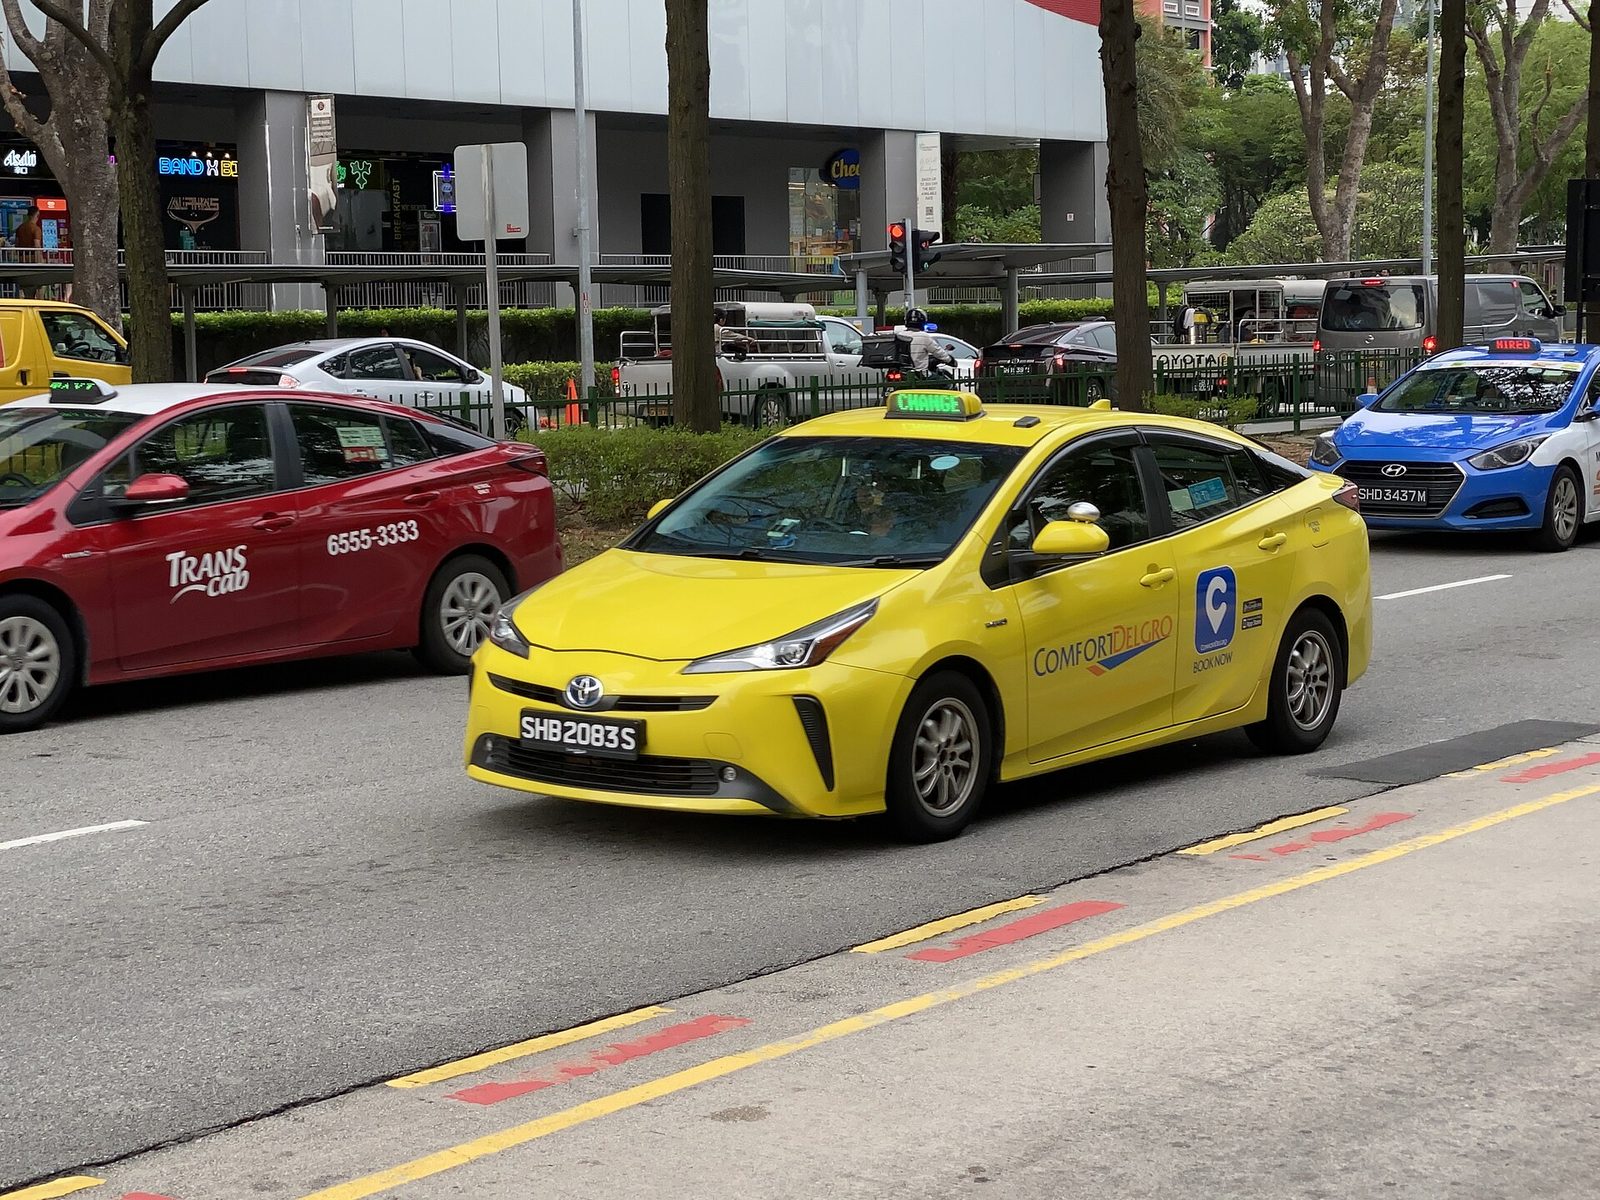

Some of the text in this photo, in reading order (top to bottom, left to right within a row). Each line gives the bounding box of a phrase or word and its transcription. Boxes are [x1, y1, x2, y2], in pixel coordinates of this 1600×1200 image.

[4, 150, 37, 167] Asahi
[159, 157, 204, 175] BAND
[206, 159, 219, 176] X
[1496, 340, 1531, 350] HIRED
[897, 393, 961, 412] CHANGE
[1358, 488, 1426, 502] SHD3437M
[327, 519, 419, 556] 6555-3333
[207, 569, 250, 597] cab
[521, 716, 636, 750] SHB2083S
